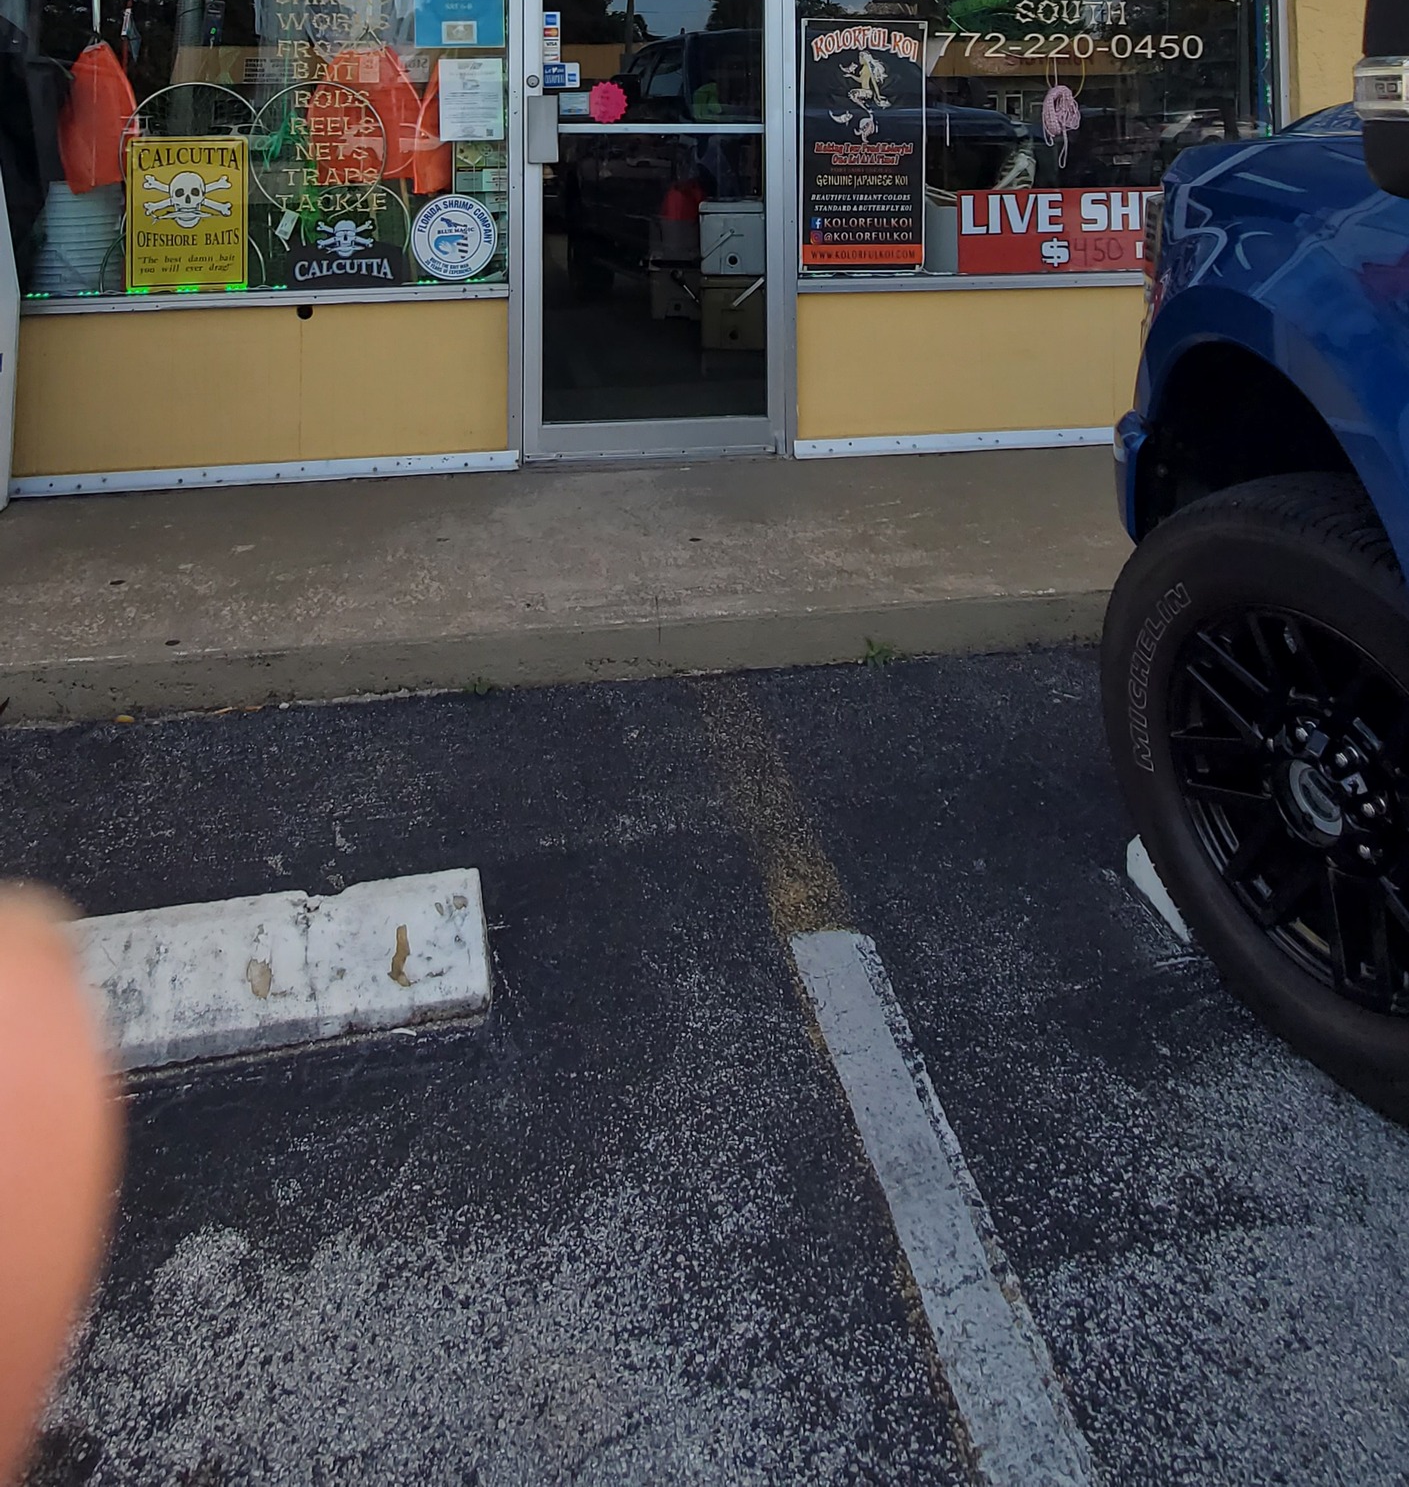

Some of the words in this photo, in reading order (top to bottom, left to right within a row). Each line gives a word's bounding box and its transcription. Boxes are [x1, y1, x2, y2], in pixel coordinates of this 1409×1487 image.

[1015, 0, 1128, 26] SOUTH
[276, 39, 387, 58] FROZEN
[890, 31, 919, 63] KOI
[934, 32, 1204, 60] 772-220-0450
[291, 61, 359, 82] BAIT
[294, 90, 370, 108] RODS
[289, 116, 375, 135] REELS
[138, 147, 241, 171] CALCUTTA
[295, 142, 369, 161] NETS
[282, 167, 379, 186] TRAPS
[853, 175, 893, 189] JAPANESE
[894, 175, 908, 186] KOI
[275, 193, 388, 212] TACKLE
[814, 204, 852, 212] STANDARD
[417, 204, 442, 233] FLORIDA
[442, 200, 474, 212] SHRIMP
[473, 208, 493, 245] COMPANY
[824, 218, 913, 228] KOLORFULKOI
[960, 193, 1064, 235] LIVE
[137, 231, 198, 247] OFFSHORE
[205, 228, 240, 245] BAITS
[823, 232, 913, 242] @KOLORFULKOI
[164, 255, 182, 263] best
[188, 254, 213, 262] damn
[219, 253, 235, 262] bait
[140, 266, 155, 274] you
[162, 264, 180, 273] will
[185, 264, 203, 272] ever
[294, 257, 394, 282] CALCUTTA
[1128, 582, 1192, 773] MICHELIN
